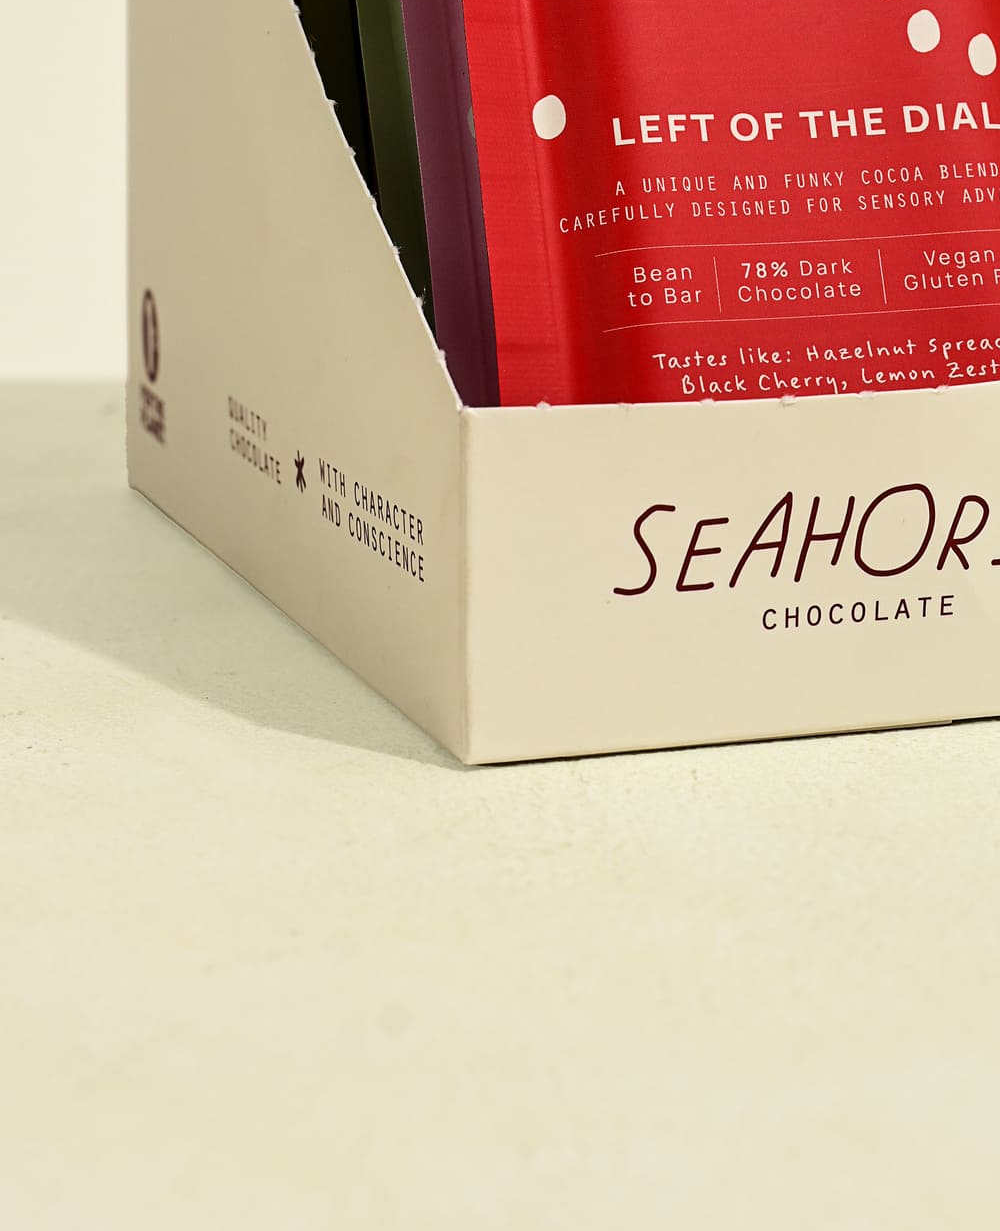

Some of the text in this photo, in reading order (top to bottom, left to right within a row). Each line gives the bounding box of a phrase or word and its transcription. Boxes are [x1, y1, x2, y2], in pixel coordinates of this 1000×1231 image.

[612, 102, 1000, 146] LEFT OF THE DIAL
[615, 181, 625, 196] A
[642, 176, 717, 193] UNIQUE
[733, 175, 768, 191] AND
[784, 171, 844, 189] FUNKY
[861, 166, 923, 185] COCOA
[559, 202, 675, 233] CAREFULLY
[692, 199, 790, 217] DESIGNED
[807, 197, 842, 214] FOR
[858, 190, 945, 211] SENSORY
[633, 266, 692, 284] Bean
[741, 259, 853, 279] 78% Dark
[923, 249, 995, 268] Vegan
[627, 288, 702, 307] to Bar
[738, 282, 862, 303] Chocolate
[904, 272, 984, 291] Gluten
[652, 351, 728, 370] Tastes
[739, 347, 791, 365] like:
[806, 339, 917, 362] Hazelnut
[682, 374, 747, 395] Black
[758, 372, 848, 394] Cherry,
[946, 359, 1000, 378] Zest
[228, 395, 267, 442] QUALITY
[229, 428, 281, 485] CHOCOLATE
[319, 458, 424, 546] WITH CHARACTER
[322, 494, 425, 582] AND CONSCIENCE
[762, 595, 956, 631] CHOCOLATE
